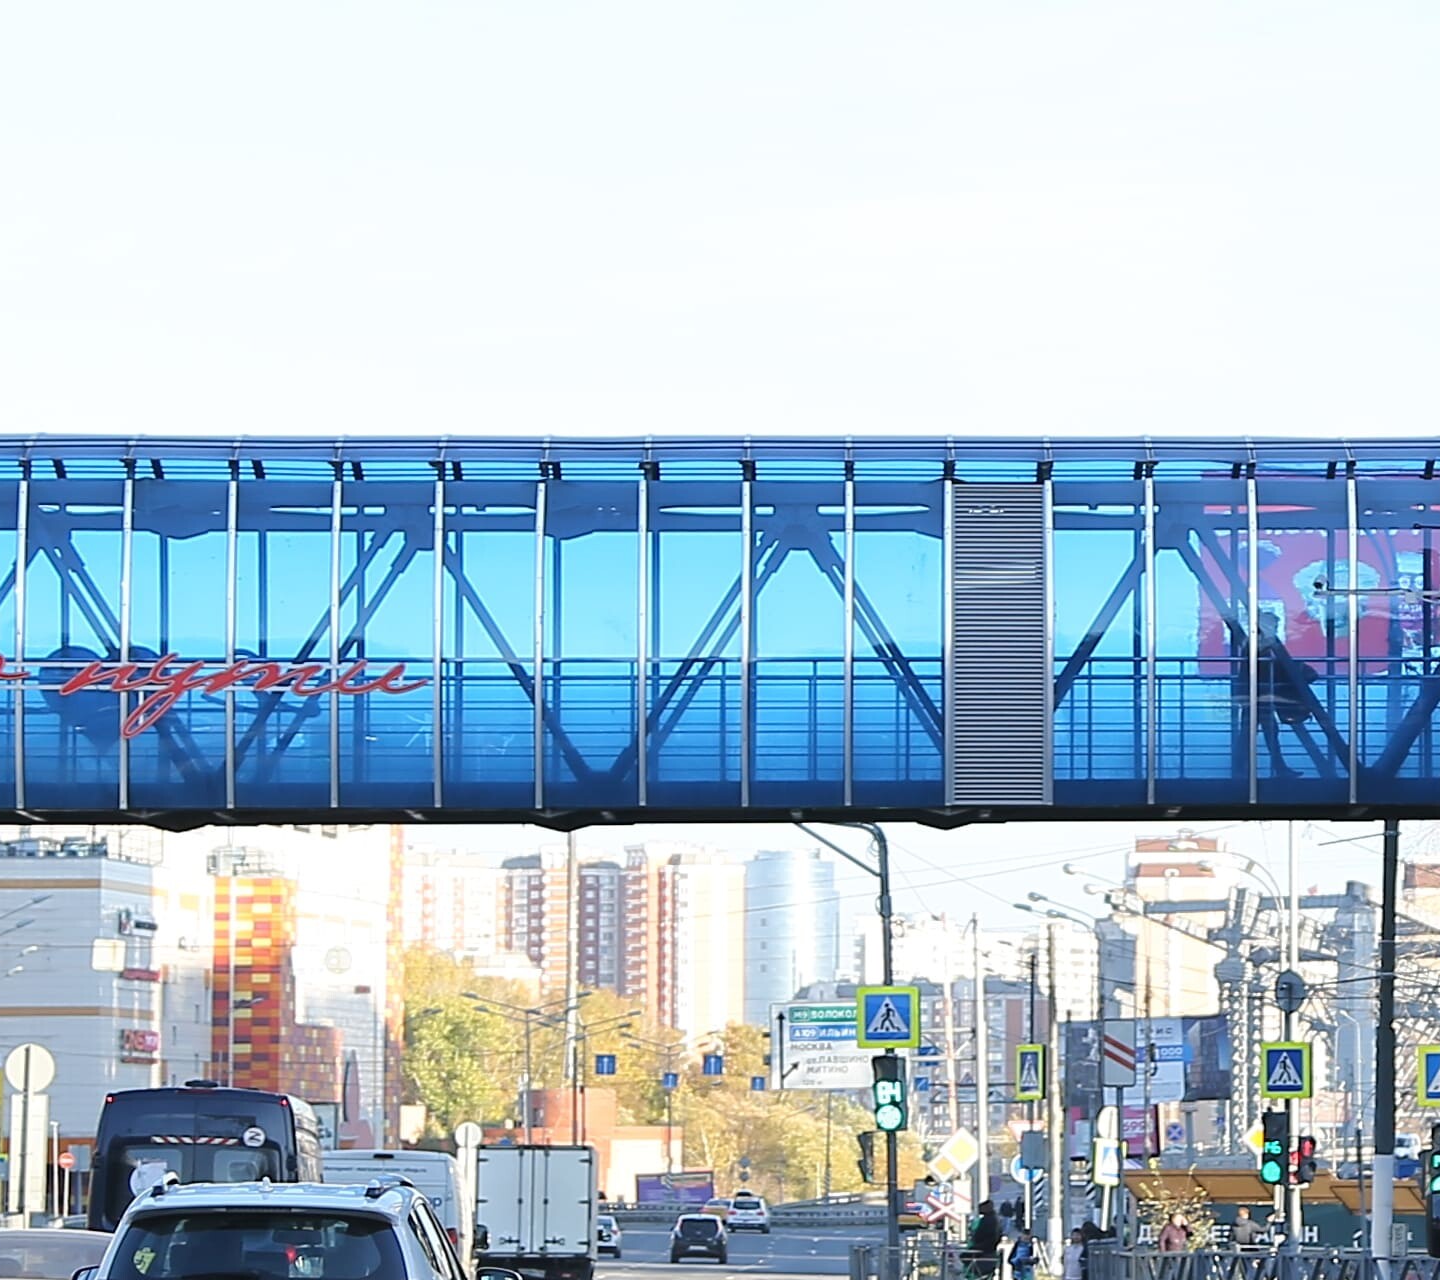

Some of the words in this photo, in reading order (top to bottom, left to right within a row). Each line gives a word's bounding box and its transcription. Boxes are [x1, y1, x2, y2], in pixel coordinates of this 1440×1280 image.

[61, 650, 435, 738] пути
[810, 1008, 858, 1019] ВОЛОКОЛ
[819, 1025, 857, 1037] ИЛЬИН
